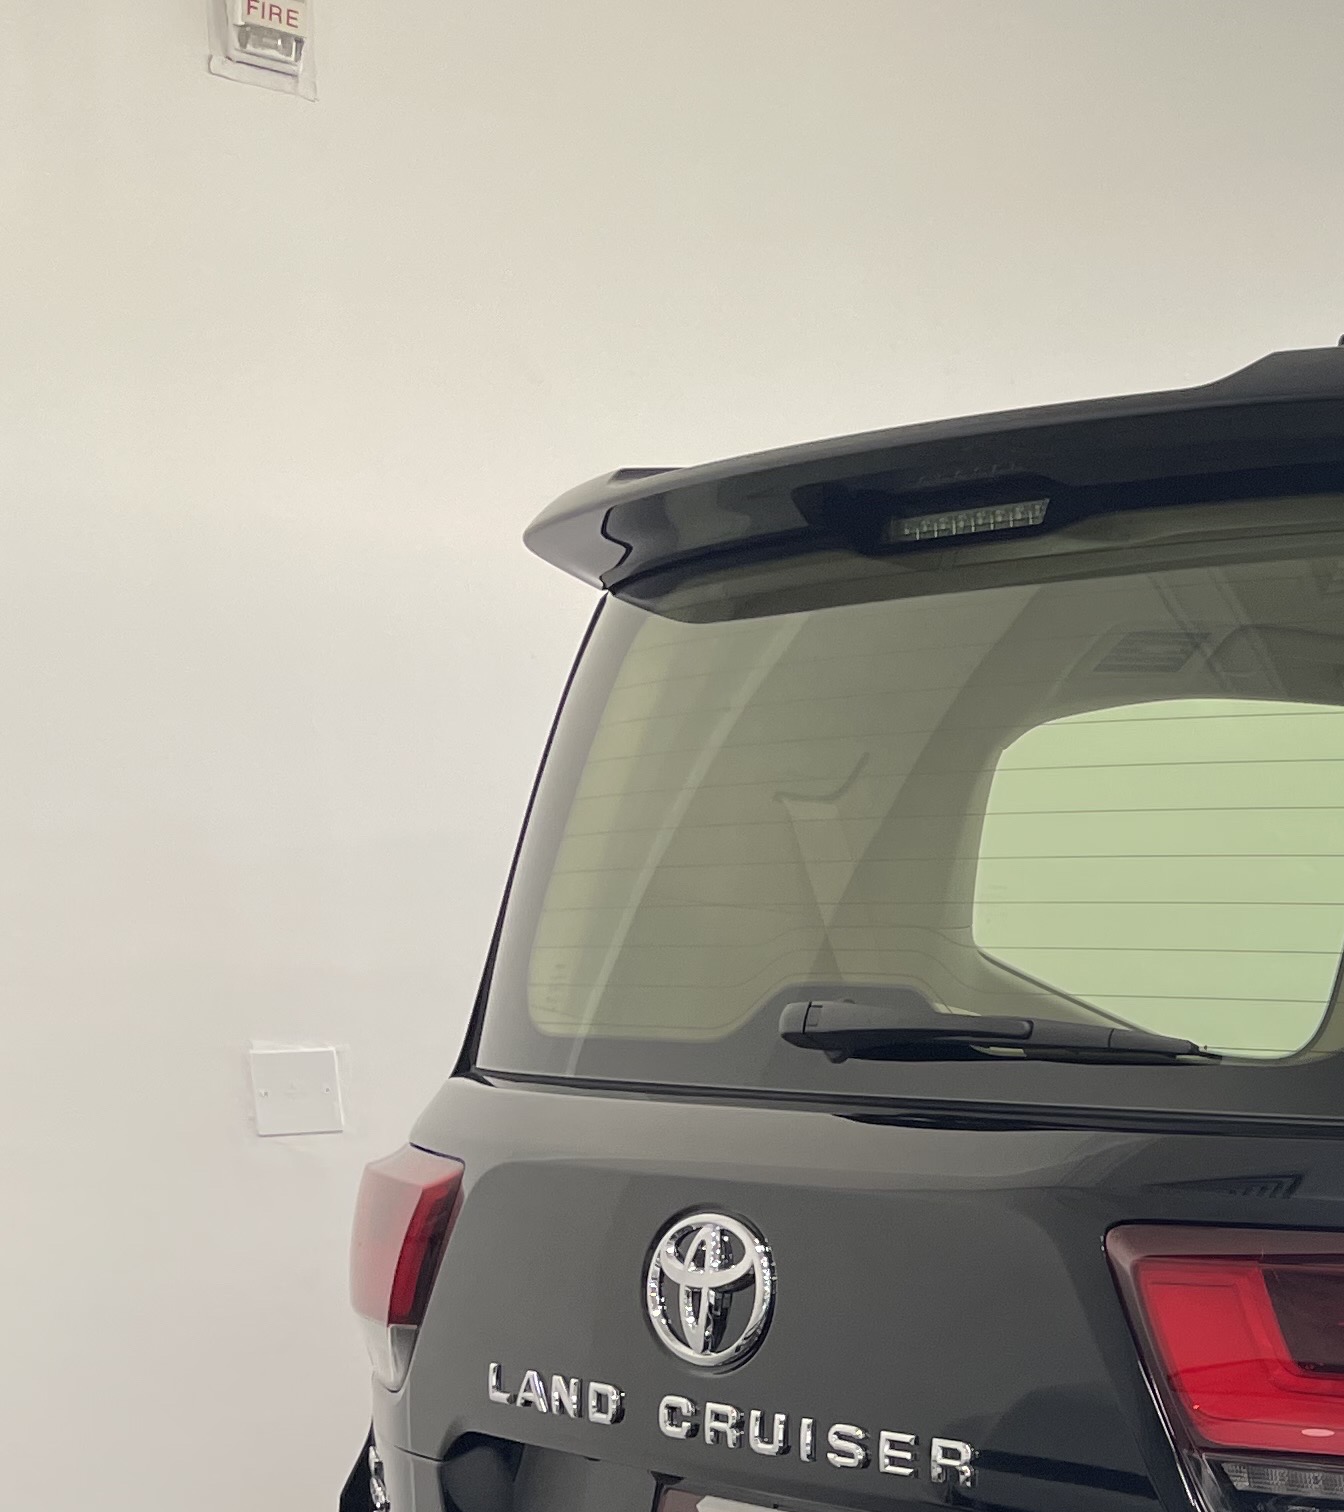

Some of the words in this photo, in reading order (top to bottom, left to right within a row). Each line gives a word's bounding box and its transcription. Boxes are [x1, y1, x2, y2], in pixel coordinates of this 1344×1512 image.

[246, 0, 299, 28] FIRE
[488, 1361, 627, 1426] LAND
[658, 1394, 979, 1488] CRUISER
